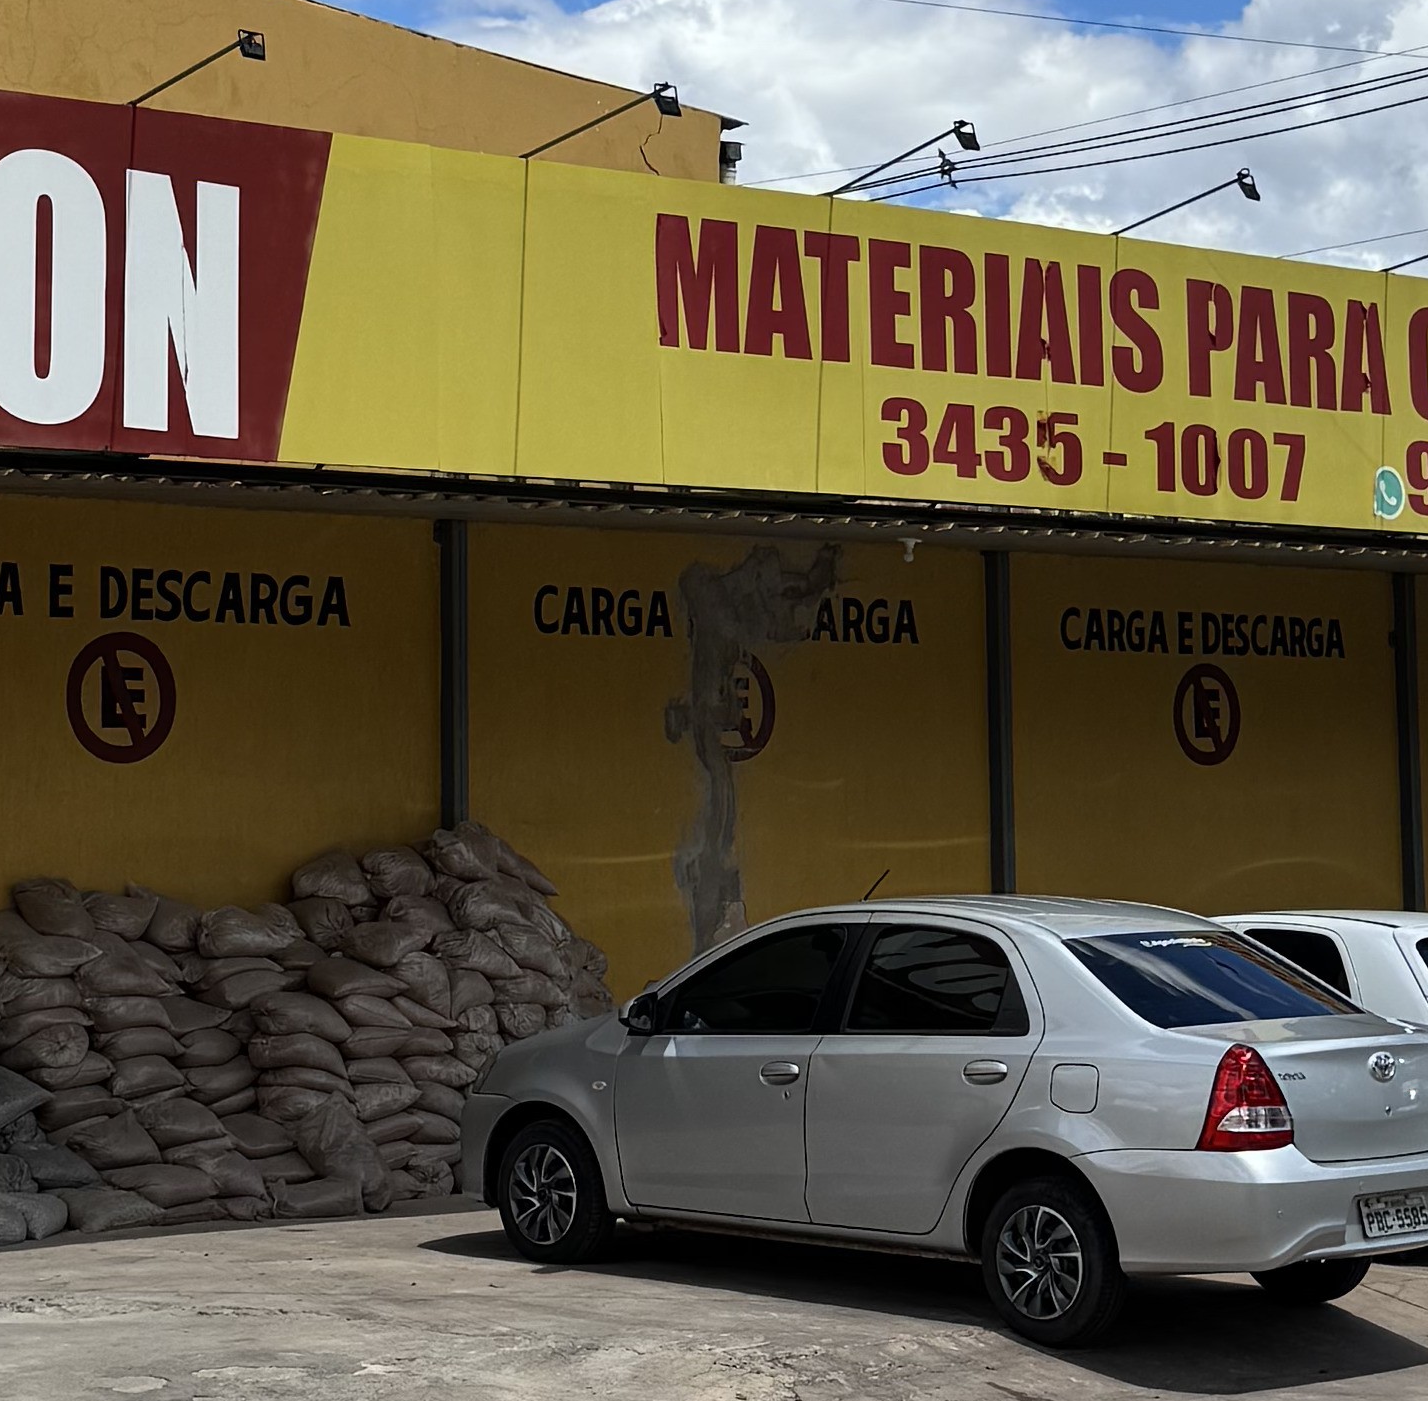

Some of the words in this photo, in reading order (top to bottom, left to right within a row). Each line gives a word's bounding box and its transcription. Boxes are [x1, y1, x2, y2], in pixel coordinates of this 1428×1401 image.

[655, 213, 1164, 394] MATERIAIS
[1185, 278, 1393, 415] PARA
[881, 397, 1084, 486] 3435
[1144, 421, 1307, 503] 1007
[48, 563, 74, 619] E
[99, 565, 352, 628] DESCARGA
[533, 584, 673, 638] CARGA
[1060, 606, 1170, 655] CARGA
[1177, 611, 1195, 655] E
[1201, 611, 1346, 660] DESCARGA
